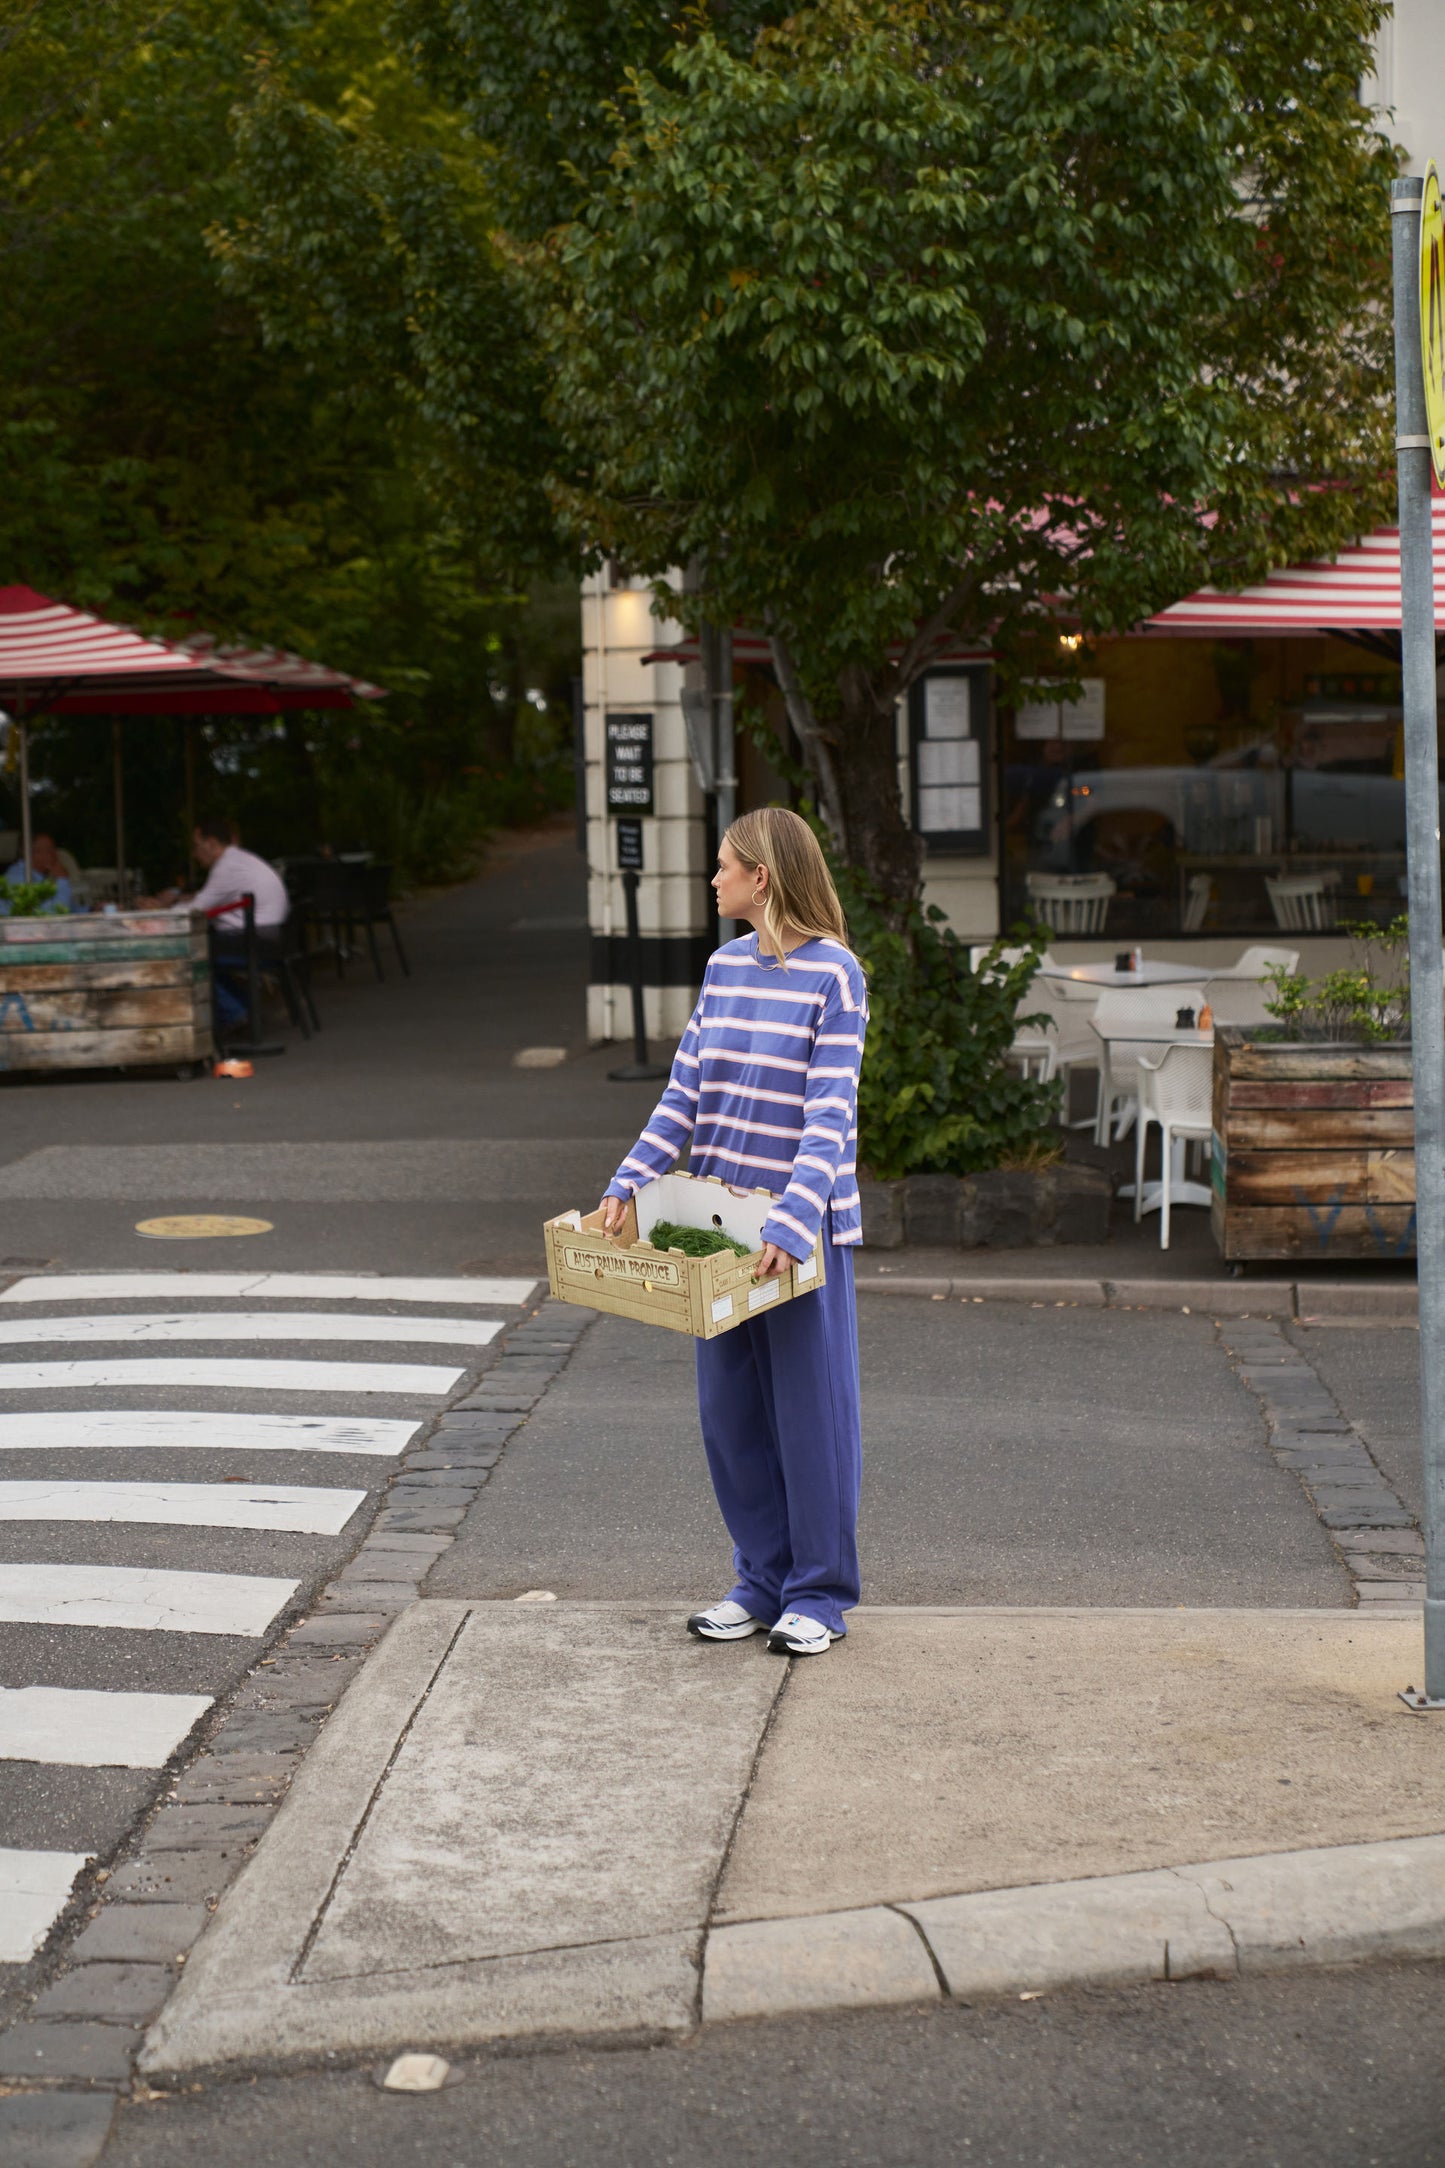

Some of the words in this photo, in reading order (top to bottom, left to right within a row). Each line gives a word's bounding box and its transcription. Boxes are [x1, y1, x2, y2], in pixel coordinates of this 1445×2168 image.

[608, 723, 649, 740] PLEASE
[614, 745, 643, 760] WAIT
[613, 766, 627, 782] TO
[628, 766, 645, 782] BE
[609, 787, 650, 804] SEATED
[573, 1251, 627, 1274] AUSTRALIAN
[628, 1260, 671, 1281] PRODUCE
